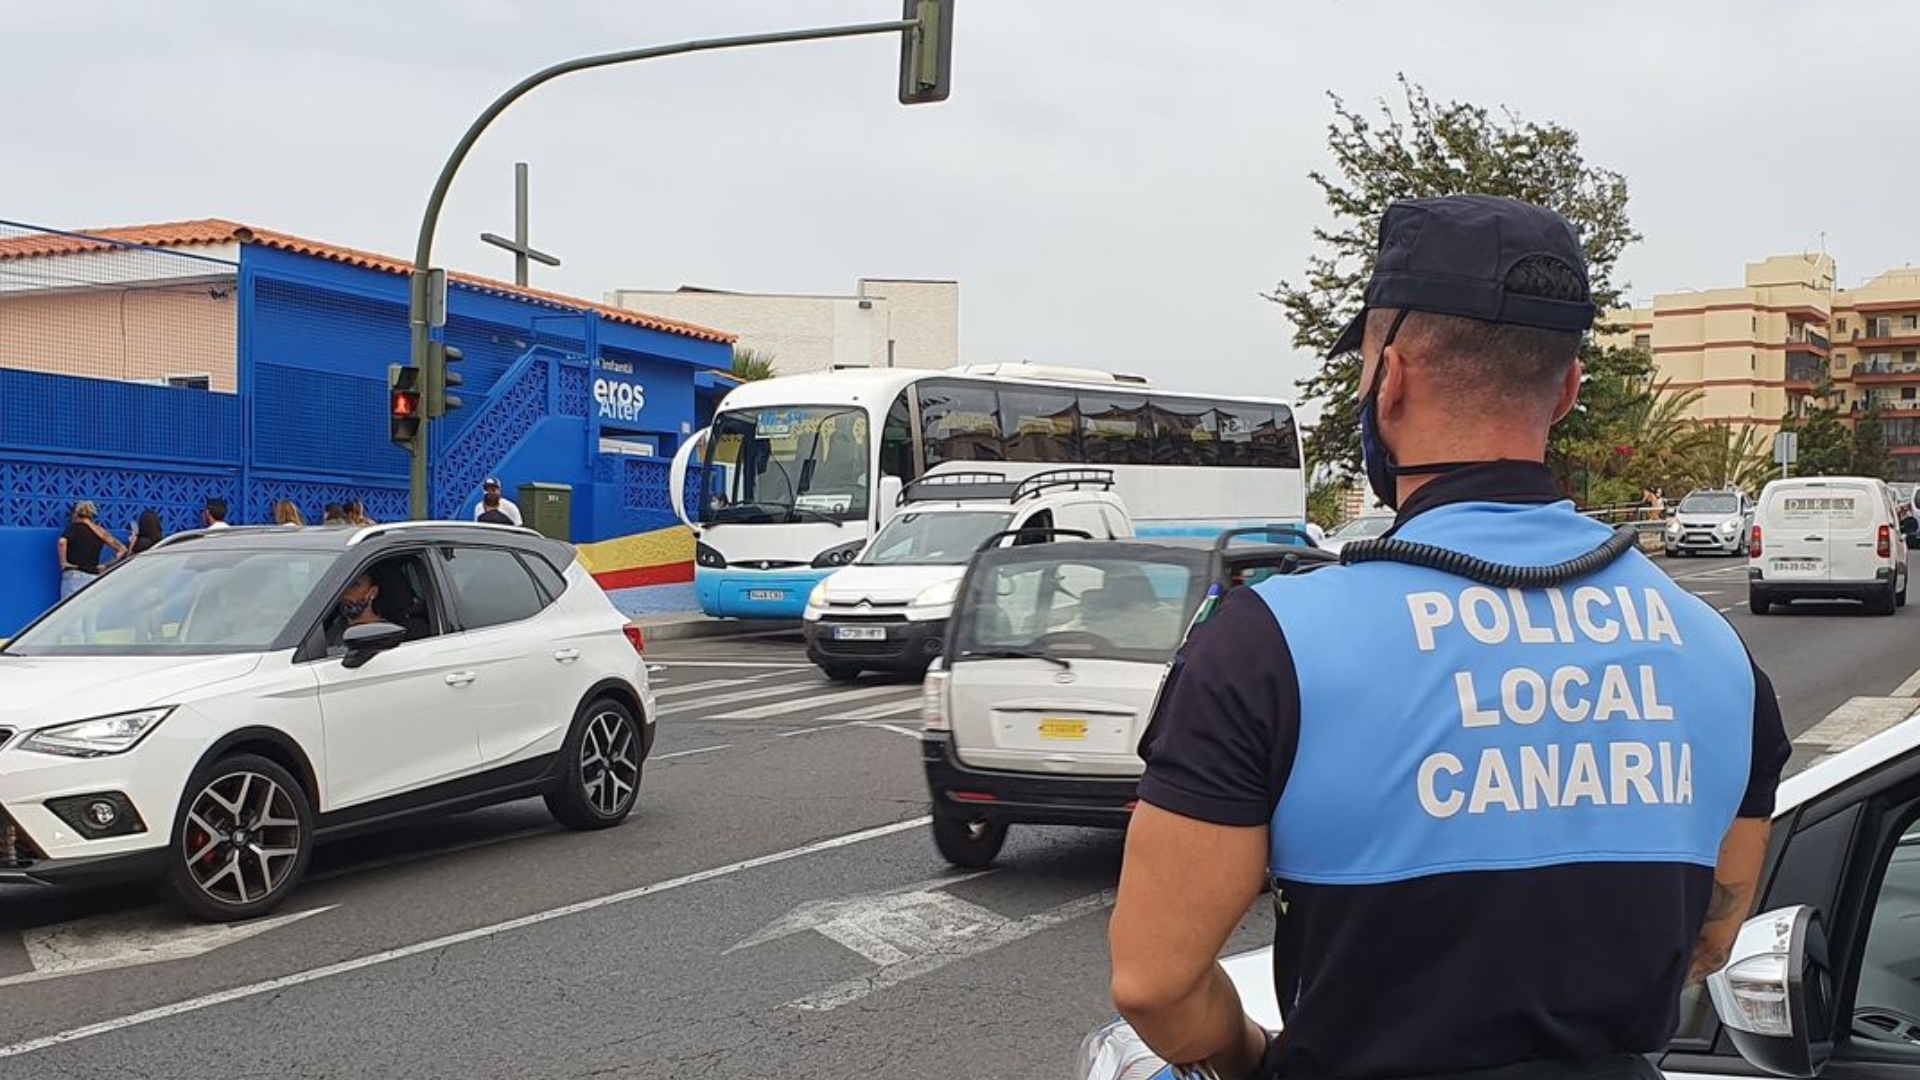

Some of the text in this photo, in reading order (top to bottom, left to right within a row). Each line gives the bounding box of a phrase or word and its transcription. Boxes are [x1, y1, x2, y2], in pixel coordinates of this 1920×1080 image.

[593, 378, 645, 409] eros
[1406, 586, 1682, 650] POLICIA
[1455, 665, 1674, 727] LOCAL
[1417, 742, 1694, 818] CANARIA
